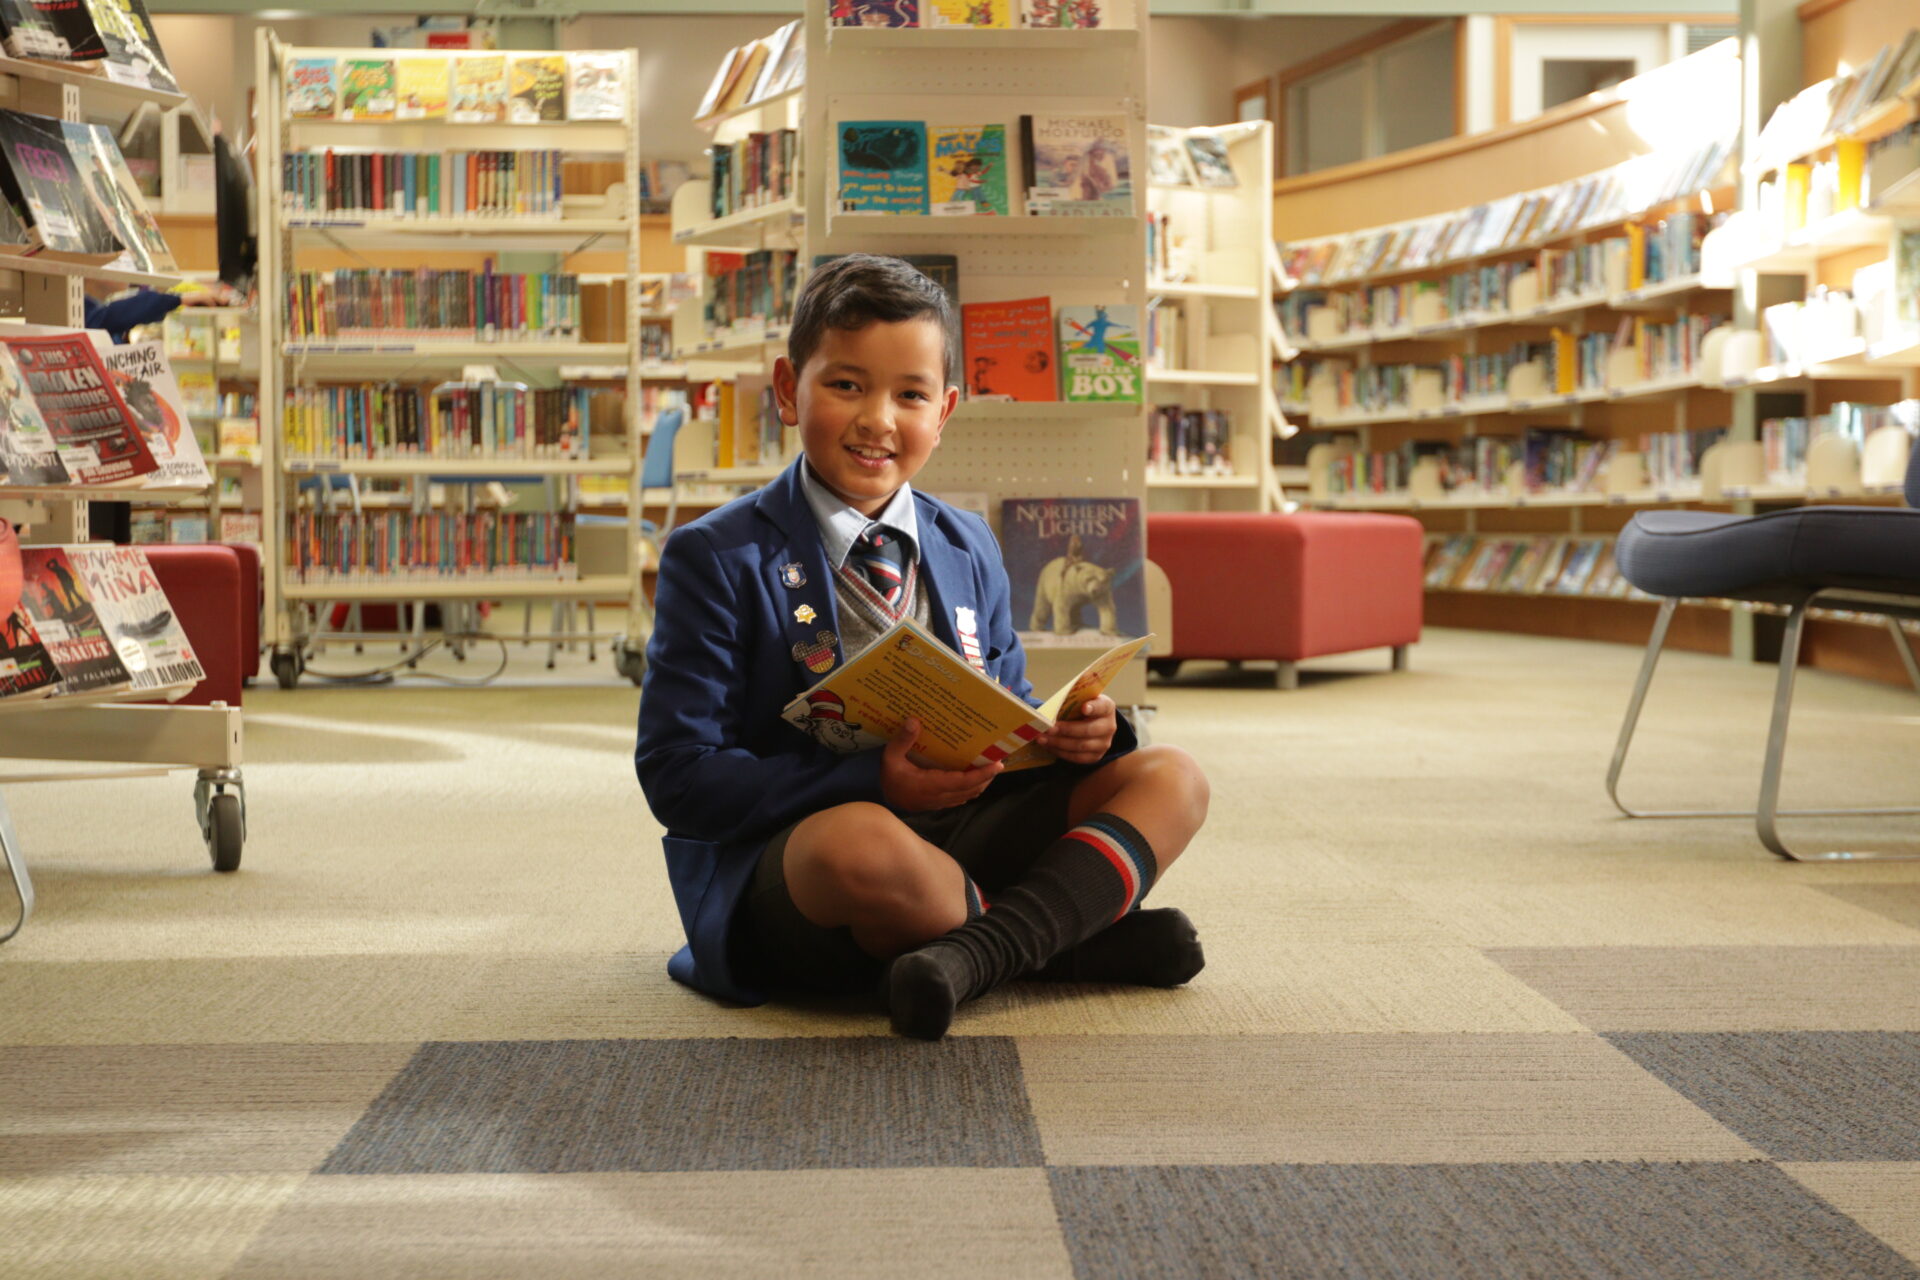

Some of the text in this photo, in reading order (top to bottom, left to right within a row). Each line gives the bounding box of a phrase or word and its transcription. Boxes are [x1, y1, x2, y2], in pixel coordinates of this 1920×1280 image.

[106, 346, 156, 371] NCHING
[140, 361, 165, 381] AIR
[1072, 375, 1136, 395] BOY
[1016, 503, 1126, 522] NORTHERN
[1038, 519, 1108, 538] LIGHTS
[88, 549, 149, 570] NAME
[50, 642, 110, 664] SSAULT
[157, 660, 203, 685] ALMOND
